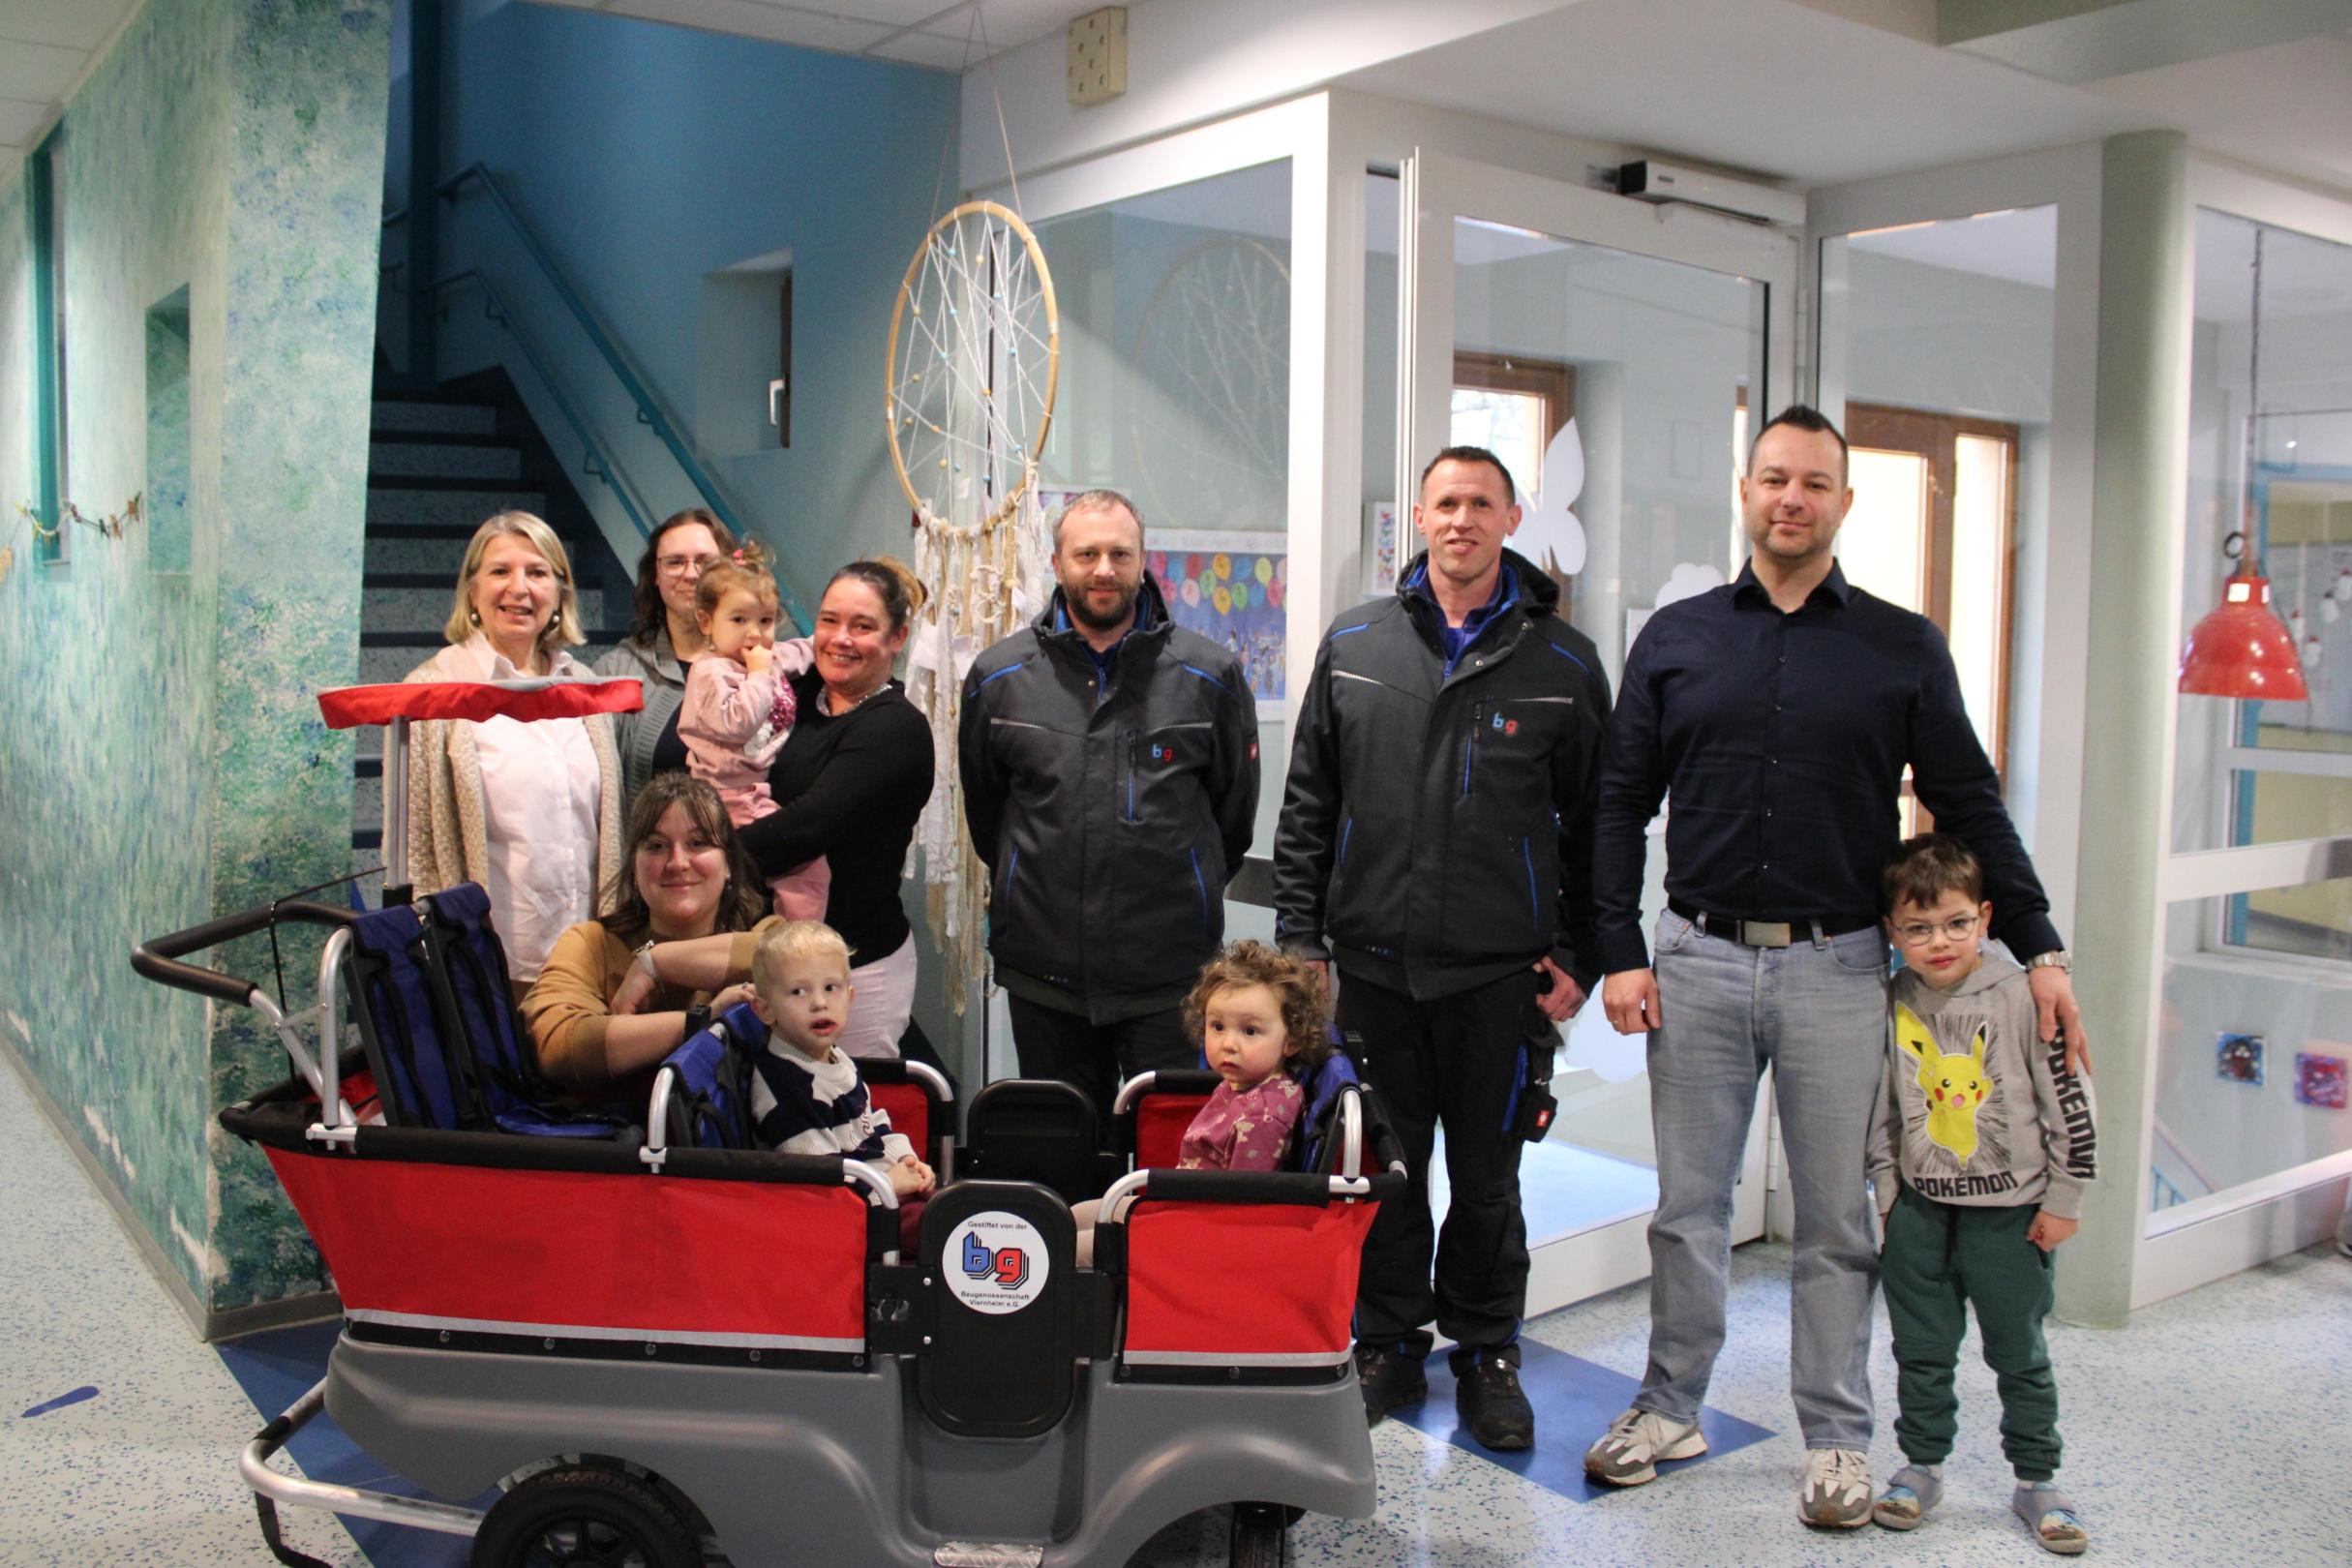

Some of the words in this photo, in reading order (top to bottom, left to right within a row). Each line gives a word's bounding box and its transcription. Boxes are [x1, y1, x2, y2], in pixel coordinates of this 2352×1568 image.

[1493, 711, 1518, 736] bg
[1152, 743, 1174, 763] bg
[968, 1220, 998, 1228] Gestiftet
[962, 1230, 1029, 1290] bg
[960, 1290, 1030, 1300] Baugenossenschaft
